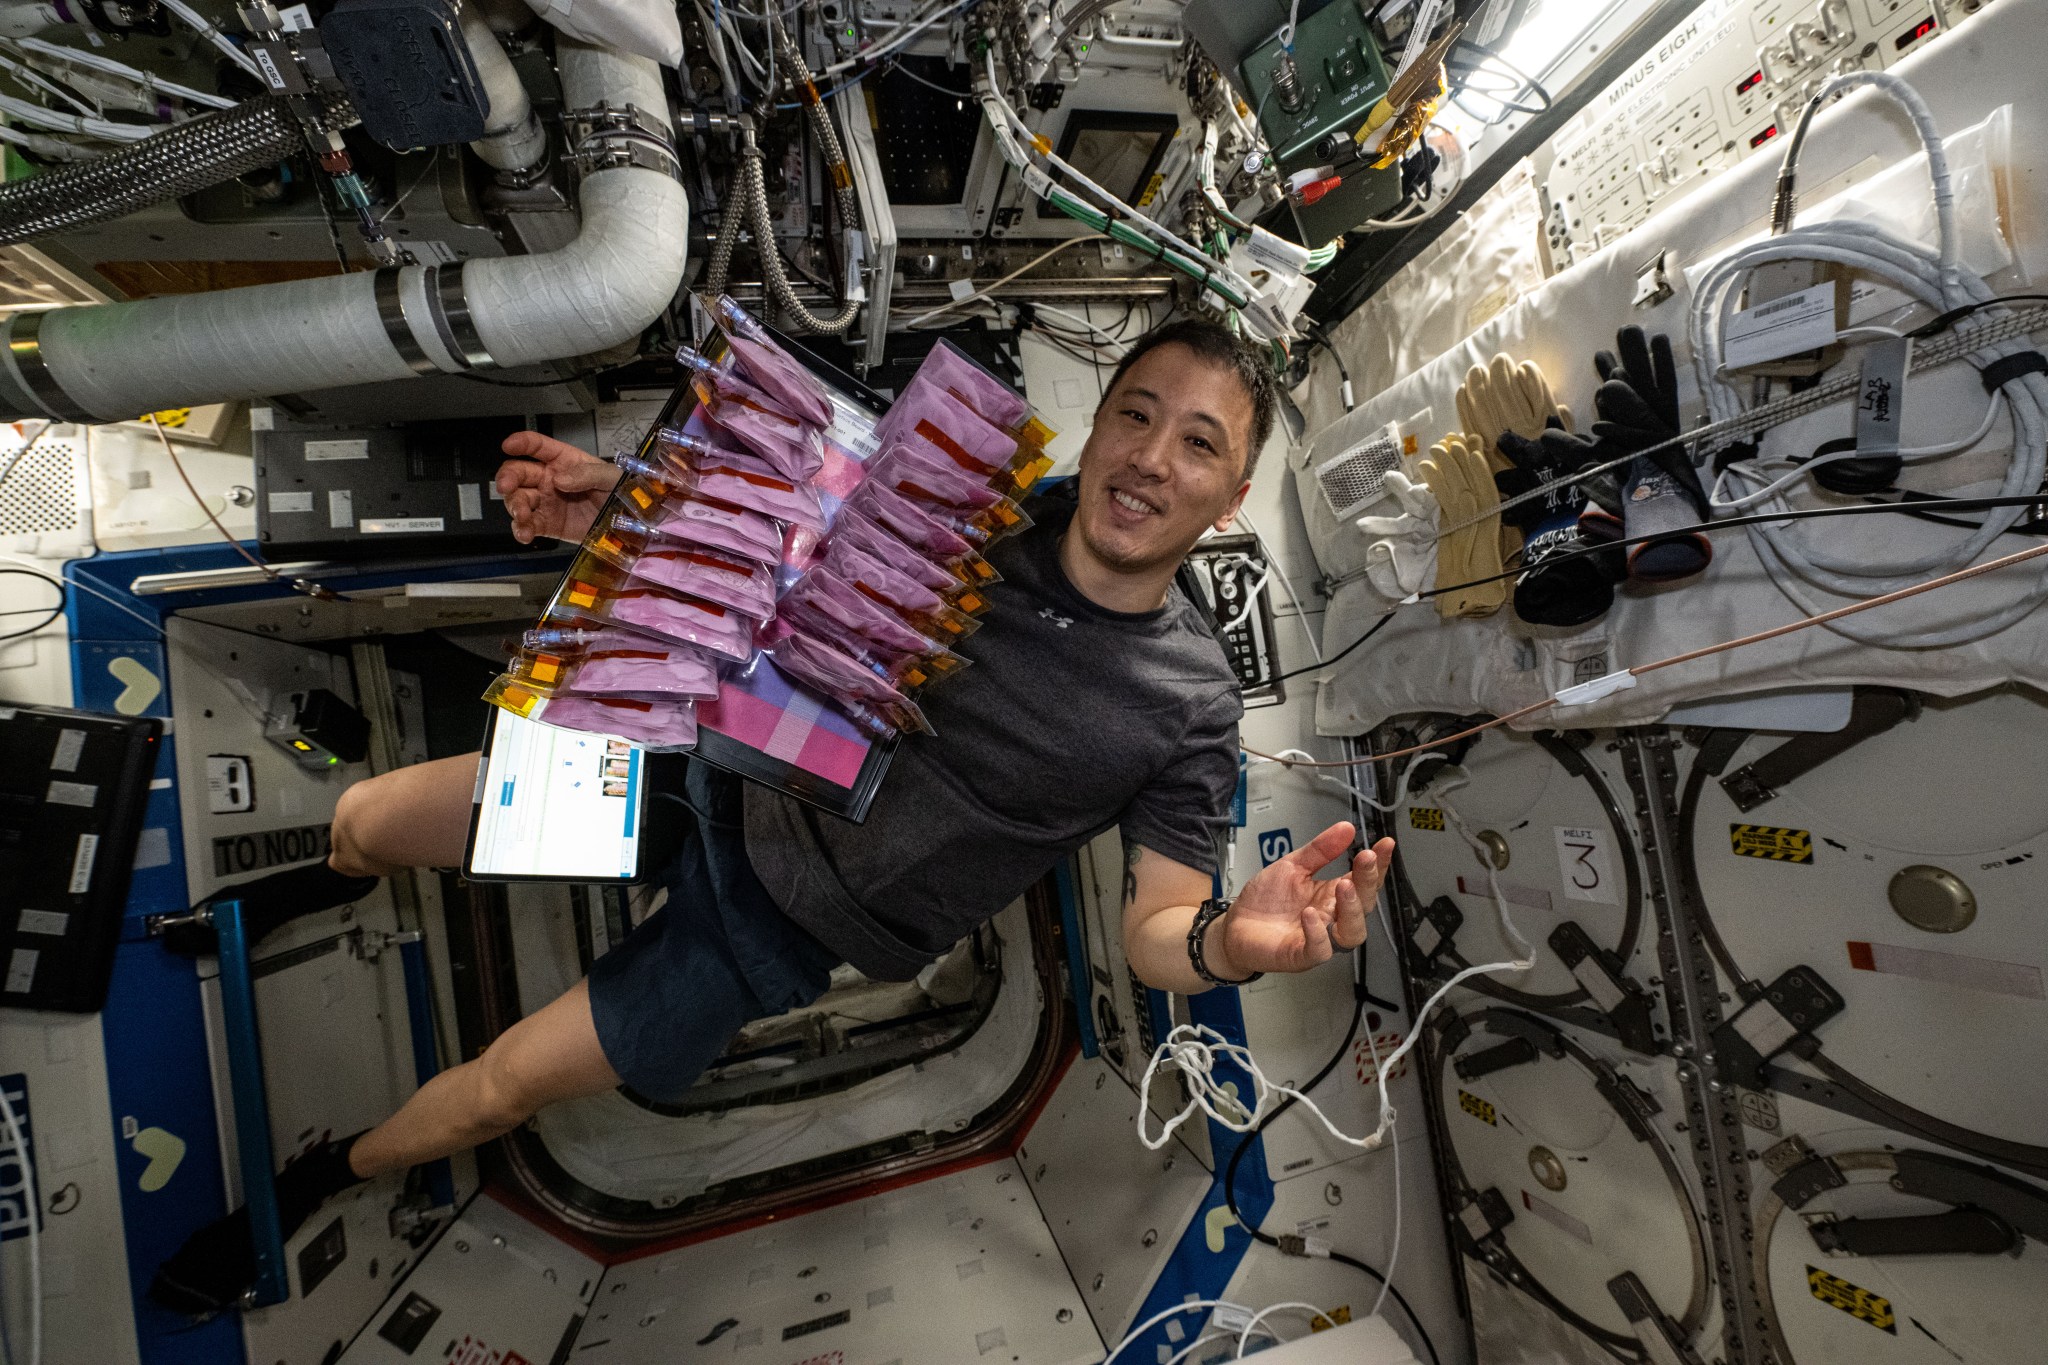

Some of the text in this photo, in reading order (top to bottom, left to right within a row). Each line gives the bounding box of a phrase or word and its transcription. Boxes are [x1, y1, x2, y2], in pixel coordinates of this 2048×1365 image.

[1336, 47, 1346, 57] OFF
[259, 52, 281, 85] To GSC
[1340, 80, 1376, 106] INPUT POWER
[1608, 61, 1656, 106] MINUS
[1570, 137, 1597, 161] MELFI
[1858, 377, 1882, 411] LAB
[408, 520, 441, 529] SERVER
[1563, 830, 1593, 840] MELFI
[215, 837, 256, 874] TO
[264, 828, 318, 867] NOD
[1564, 843, 1599, 889] 3
